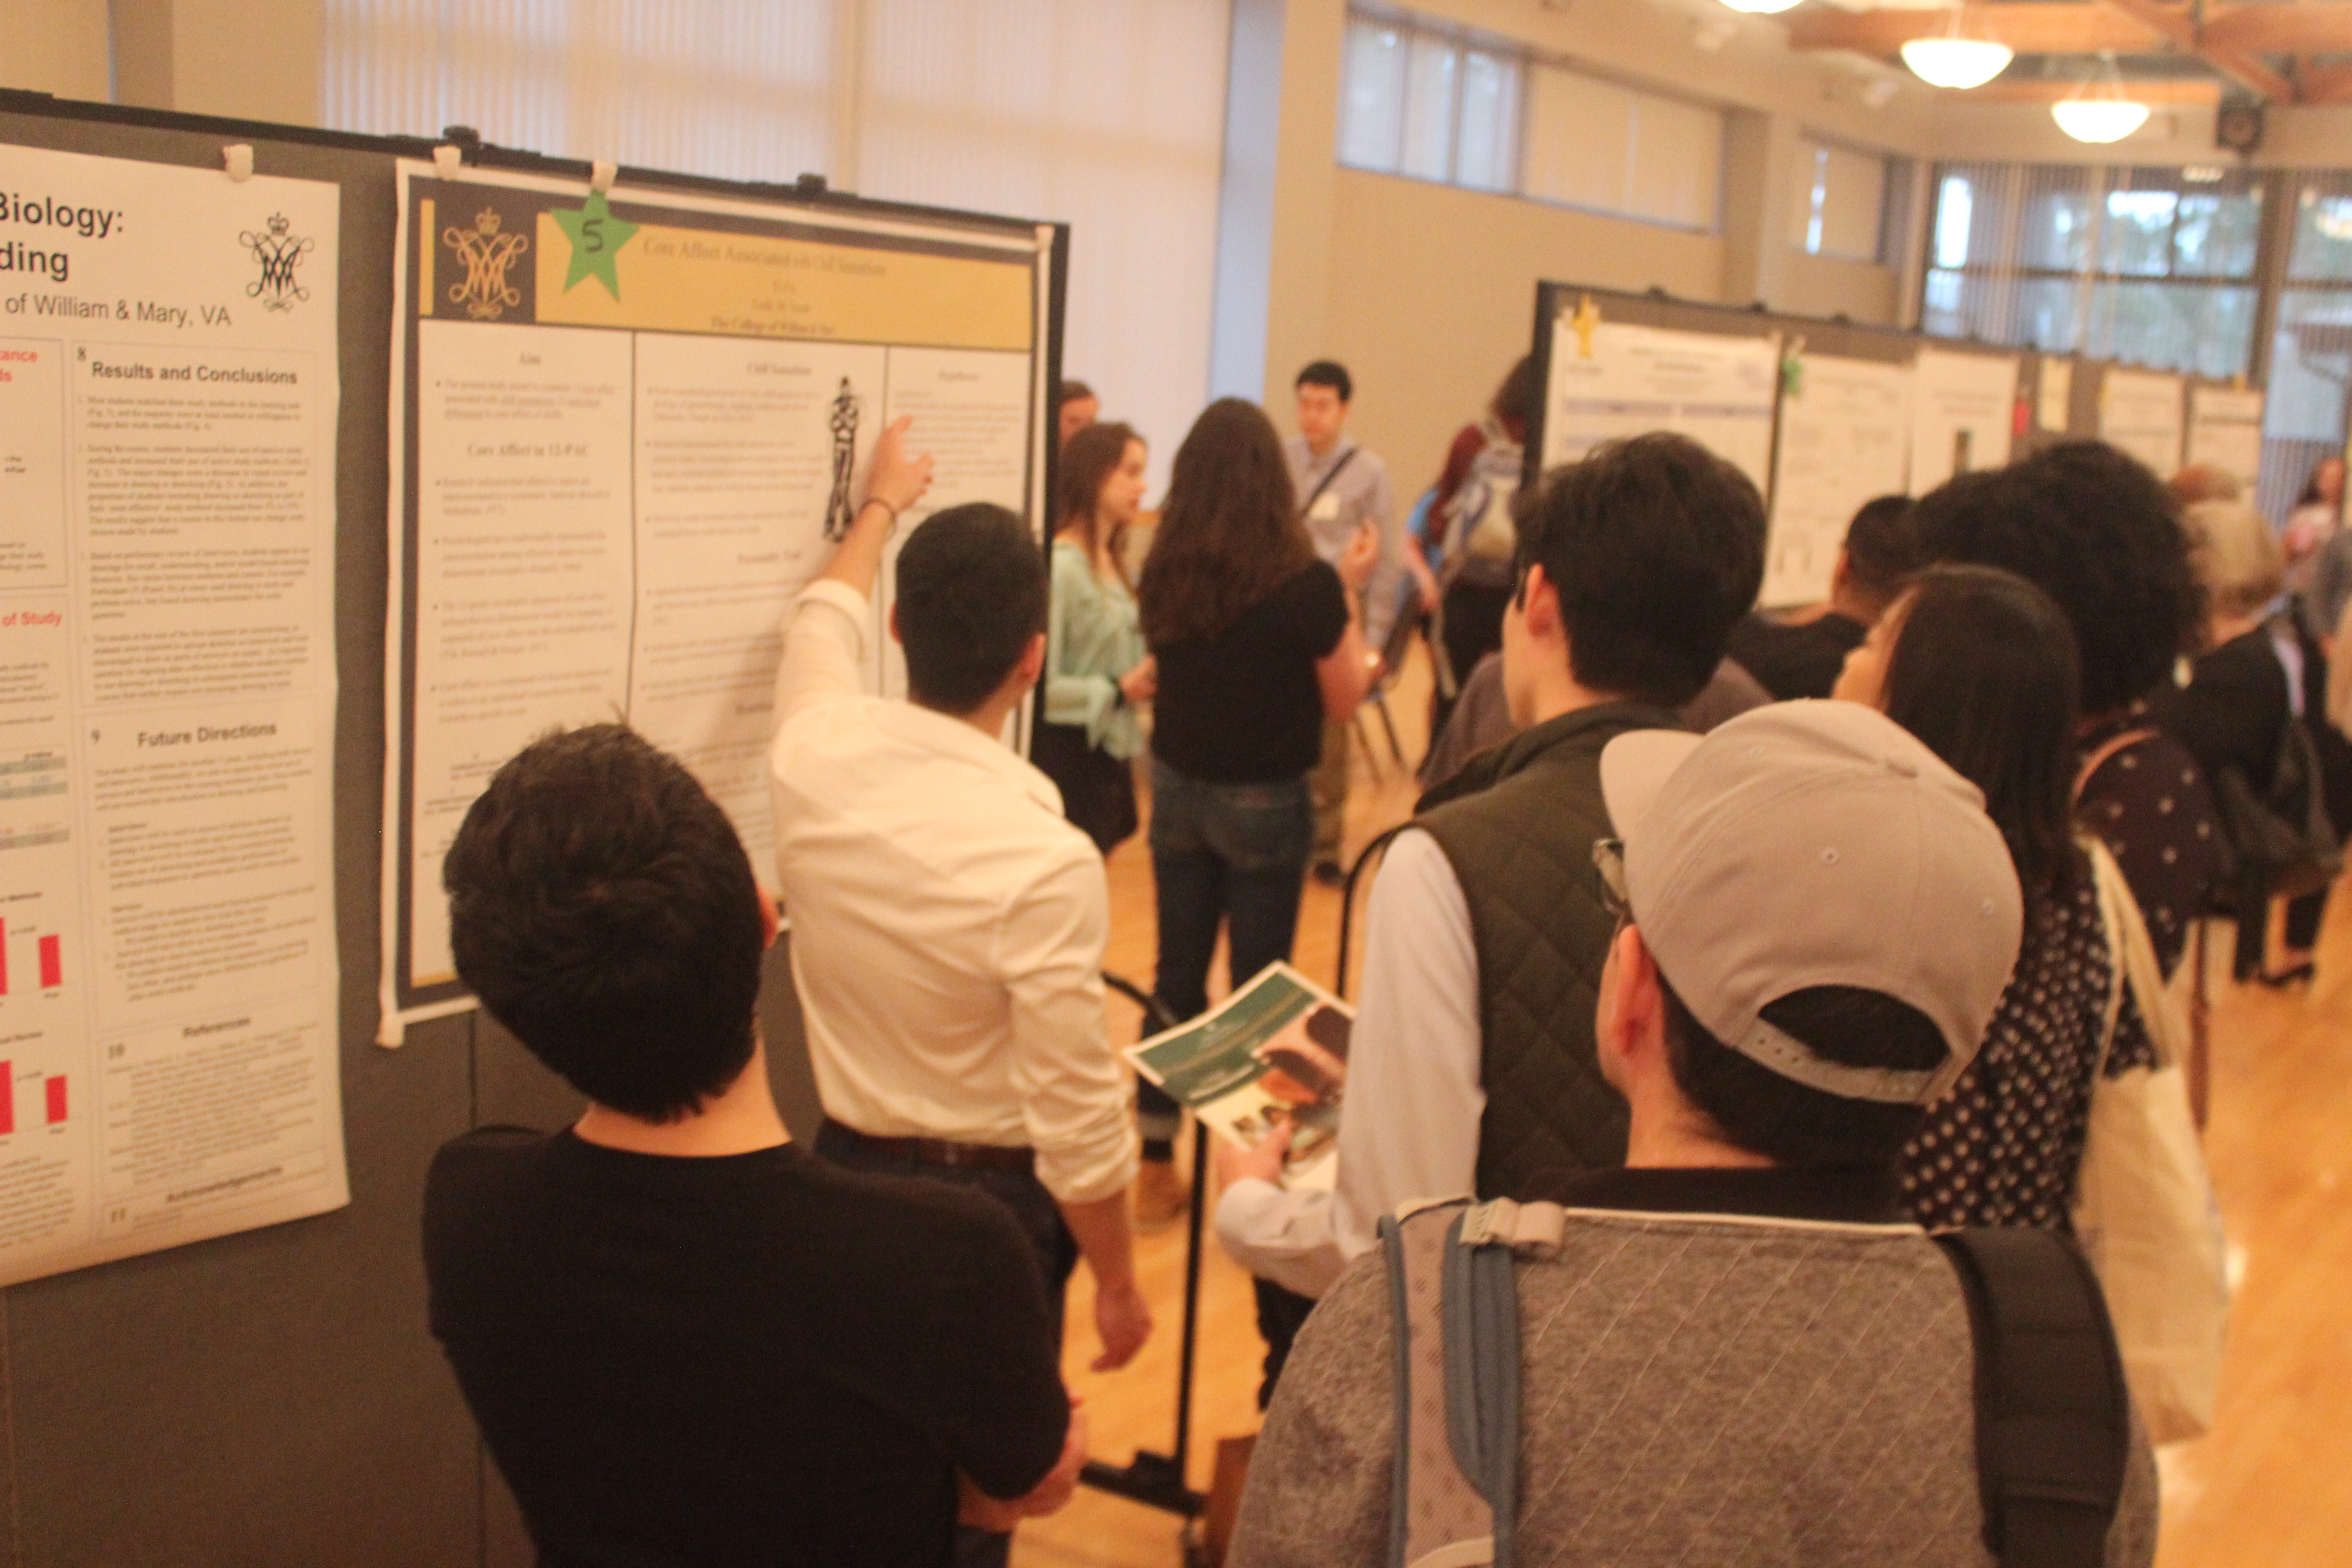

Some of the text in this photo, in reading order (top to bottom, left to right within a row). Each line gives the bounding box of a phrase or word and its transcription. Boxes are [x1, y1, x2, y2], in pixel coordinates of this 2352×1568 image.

[0, 191, 123, 239] Biology:
[582, 219, 604, 253] 5
[0, 241, 69, 282] ding
[5, 293, 232, 328] of William & Mary, VA
[76, 347, 87, 362] 8
[92, 361, 298, 385] Results and Conclusions
[2, 611, 63, 627] of Study
[137, 732, 191, 747] Future
[198, 723, 277, 743] Directions
